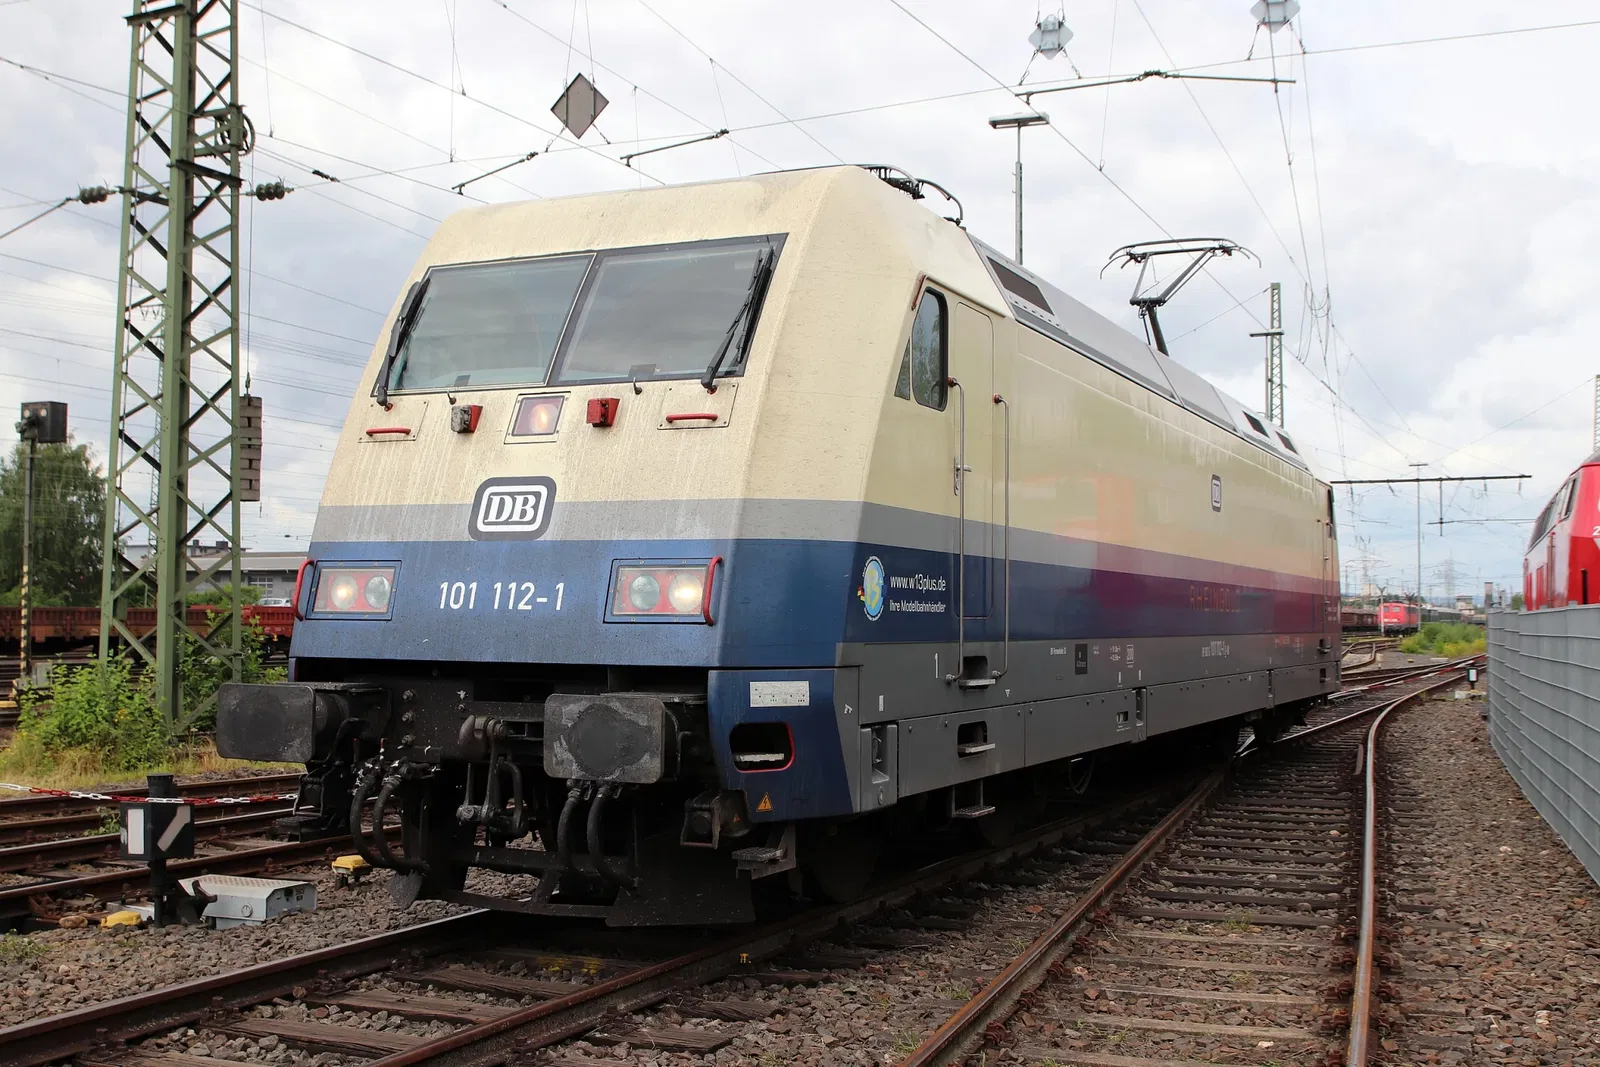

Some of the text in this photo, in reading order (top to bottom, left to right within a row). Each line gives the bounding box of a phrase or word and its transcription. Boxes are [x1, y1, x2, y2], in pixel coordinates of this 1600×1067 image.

[484, 494, 536, 522] DB
[890, 573, 946, 593] www.w13plus.de
[439, 581, 565, 611] 101 112-1
[889, 599, 901, 612] Ihre
